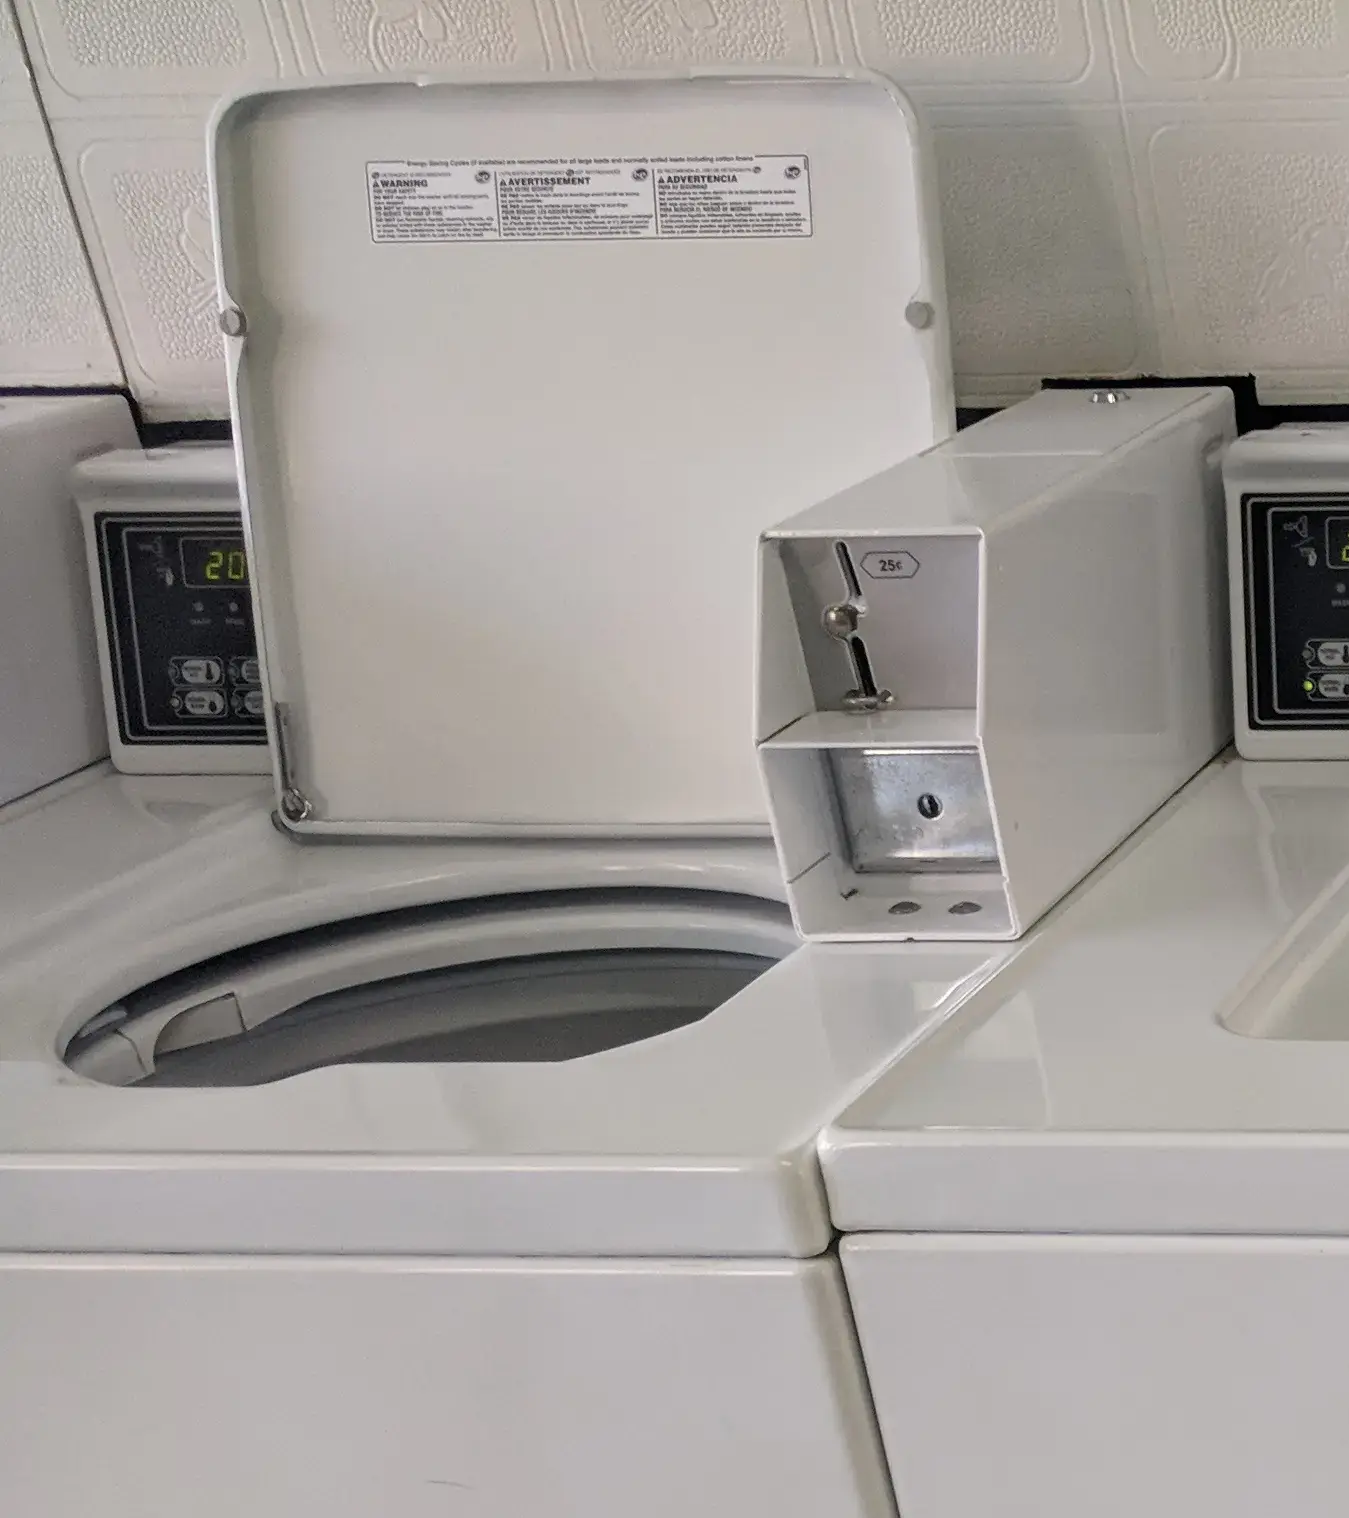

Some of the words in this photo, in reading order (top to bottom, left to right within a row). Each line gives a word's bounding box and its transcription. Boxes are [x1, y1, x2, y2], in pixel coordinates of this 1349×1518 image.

[686, 156, 714, 164] including
[508, 177, 591, 186] AVERTISSEMENT
[667, 175, 738, 183] ADVERTENCIA
[380, 179, 428, 188] WARNING
